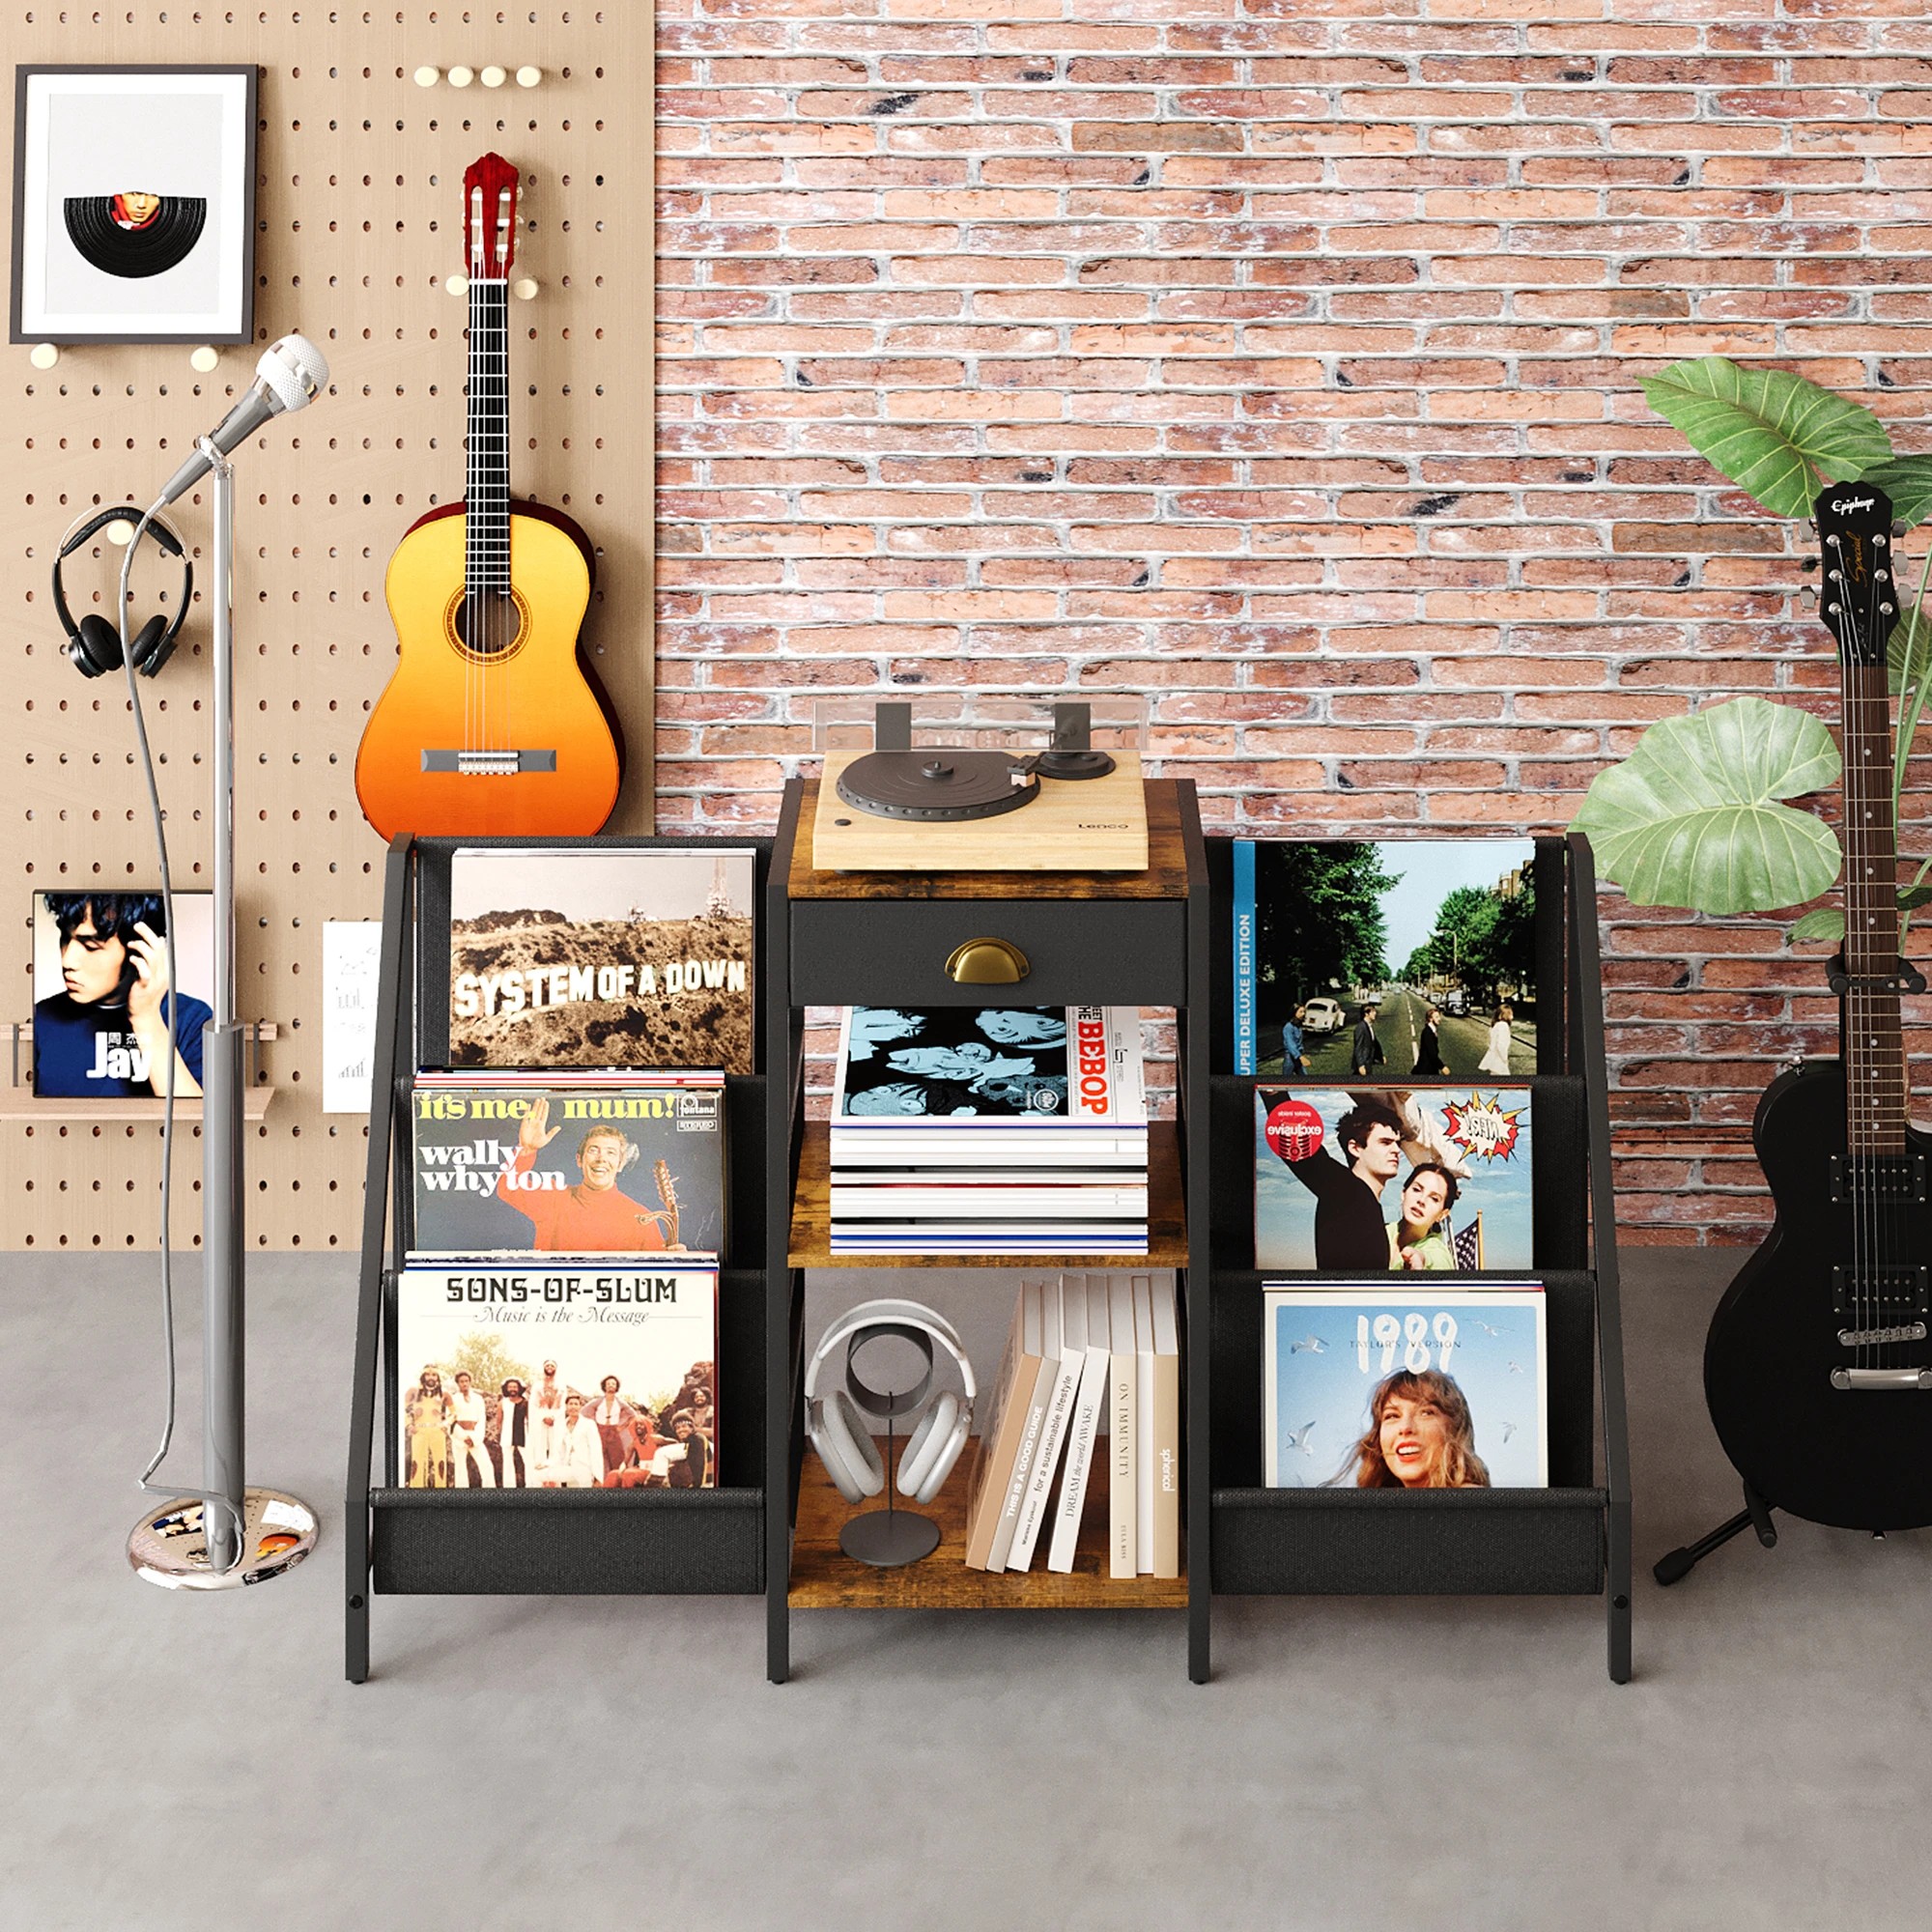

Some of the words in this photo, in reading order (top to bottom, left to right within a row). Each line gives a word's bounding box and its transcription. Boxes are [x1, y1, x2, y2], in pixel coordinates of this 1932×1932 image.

[1831, 496, 1875, 516] Epiphone
[1239, 914, 1251, 976] EDITION
[454, 966, 594, 1015] SYSTEM
[597, 966, 634, 1002] OF
[638, 964, 656, 996] A
[666, 958, 746, 994] DOWN
[1078, 1006, 1092, 1020] HE
[1239, 979, 1251, 1037] DELUXE
[108, 1032, 138, 1045] 周杰
[86, 1032, 151, 1082] Jay
[1078, 1022, 1108, 1115] BEBOP
[1240, 1039, 1251, 1075] UPER
[563, 1093, 674, 1119] mum!
[419, 1139, 524, 1171] wally
[420, 1165, 568, 1198] whyton
[446, 1277, 677, 1302] SONS-OF-SLUM
[473, 1306, 530, 1323] Music
[535, 1310, 549, 1323] is
[552, 1306, 574, 1323] the
[579, 1306, 650, 1327] Message
[1357, 1312, 1458, 1375] 1989
[1409, 1340, 1461, 1349] VERSION
[1119, 1382, 1129, 1401] ON
[1028, 1406, 1043, 1438] GUIDE
[1033, 1479, 1044, 1492] for
[1042, 1413, 1063, 1468] sustainable
[1055, 1375, 1072, 1412] lifestyle
[1019, 1439, 1034, 1471] GOOD
[1119, 1407, 1129, 1478] IMMUNITY
[1065, 1477, 1081, 1518] DREAM
[1079, 1405, 1094, 1443] AWAKE
[1013, 1483, 1022, 1494] IS
[1017, 1473, 1025, 1483] A
[1007, 1494, 1019, 1518] THIS
